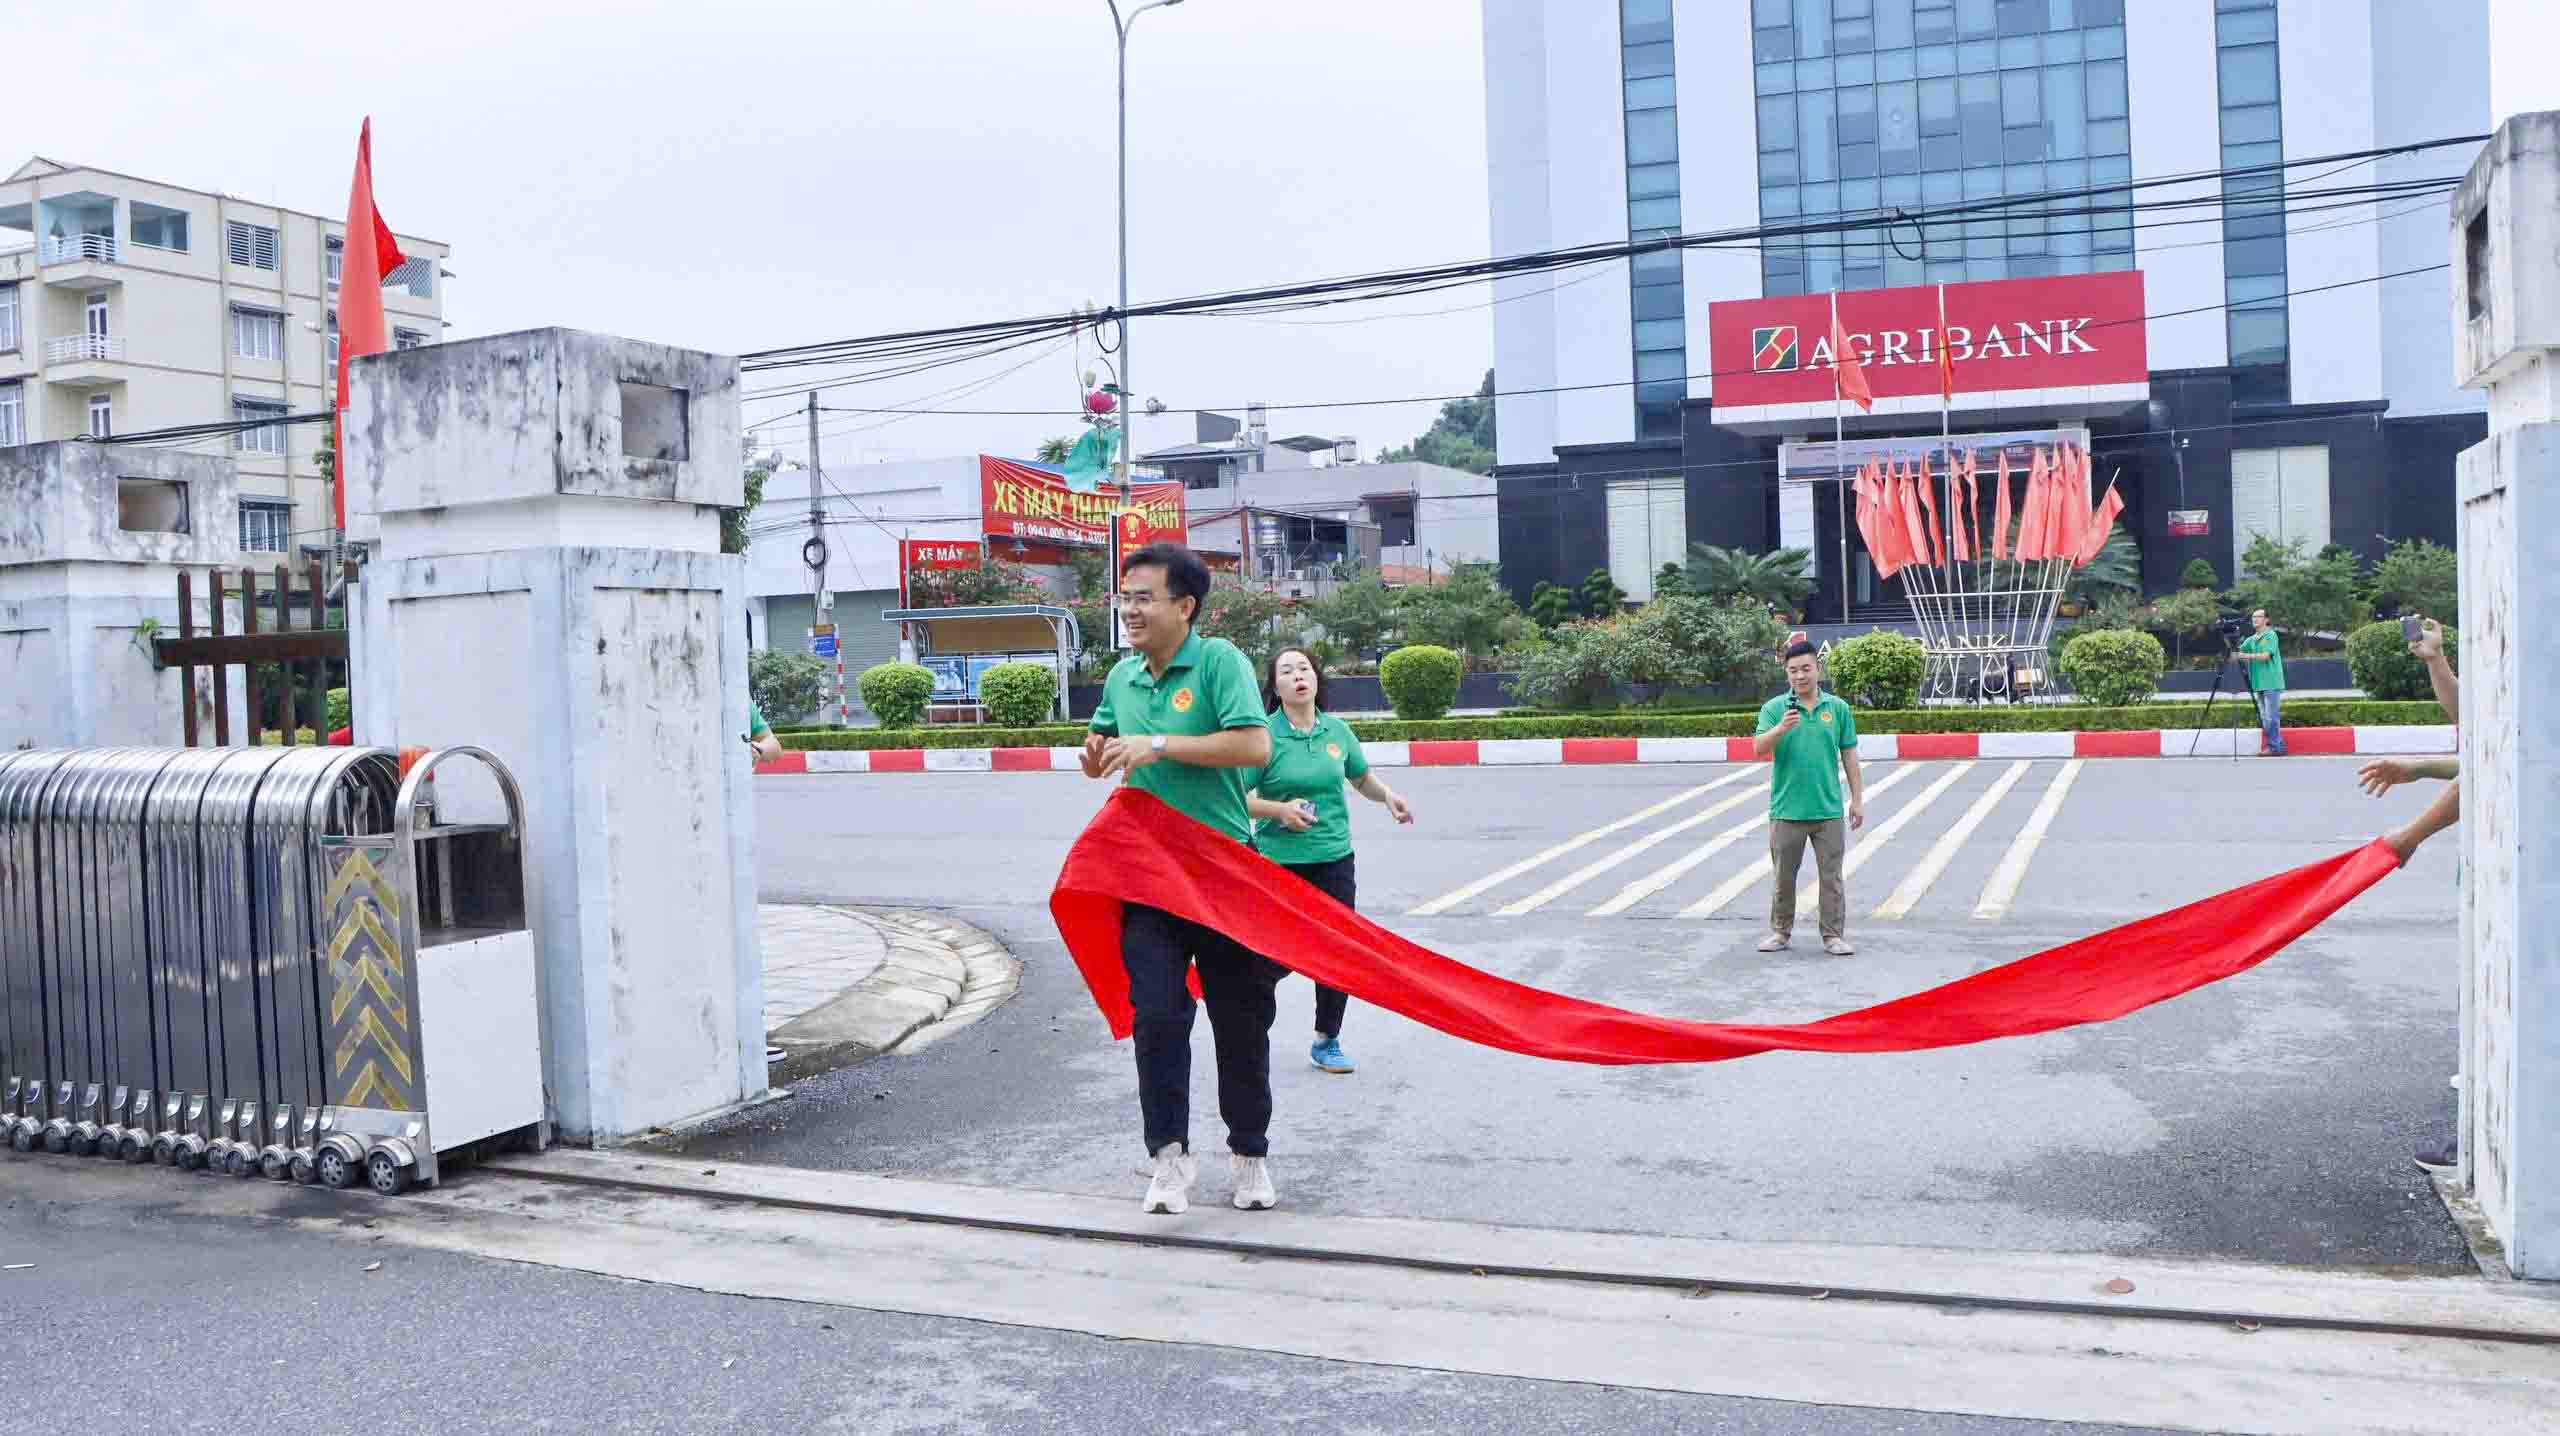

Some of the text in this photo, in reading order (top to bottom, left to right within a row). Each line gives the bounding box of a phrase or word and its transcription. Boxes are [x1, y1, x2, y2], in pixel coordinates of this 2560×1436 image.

[1804, 317, 2101, 370] AGRIBANK
[993, 479, 1018, 515] XE
[918, 546, 934, 561] XE
